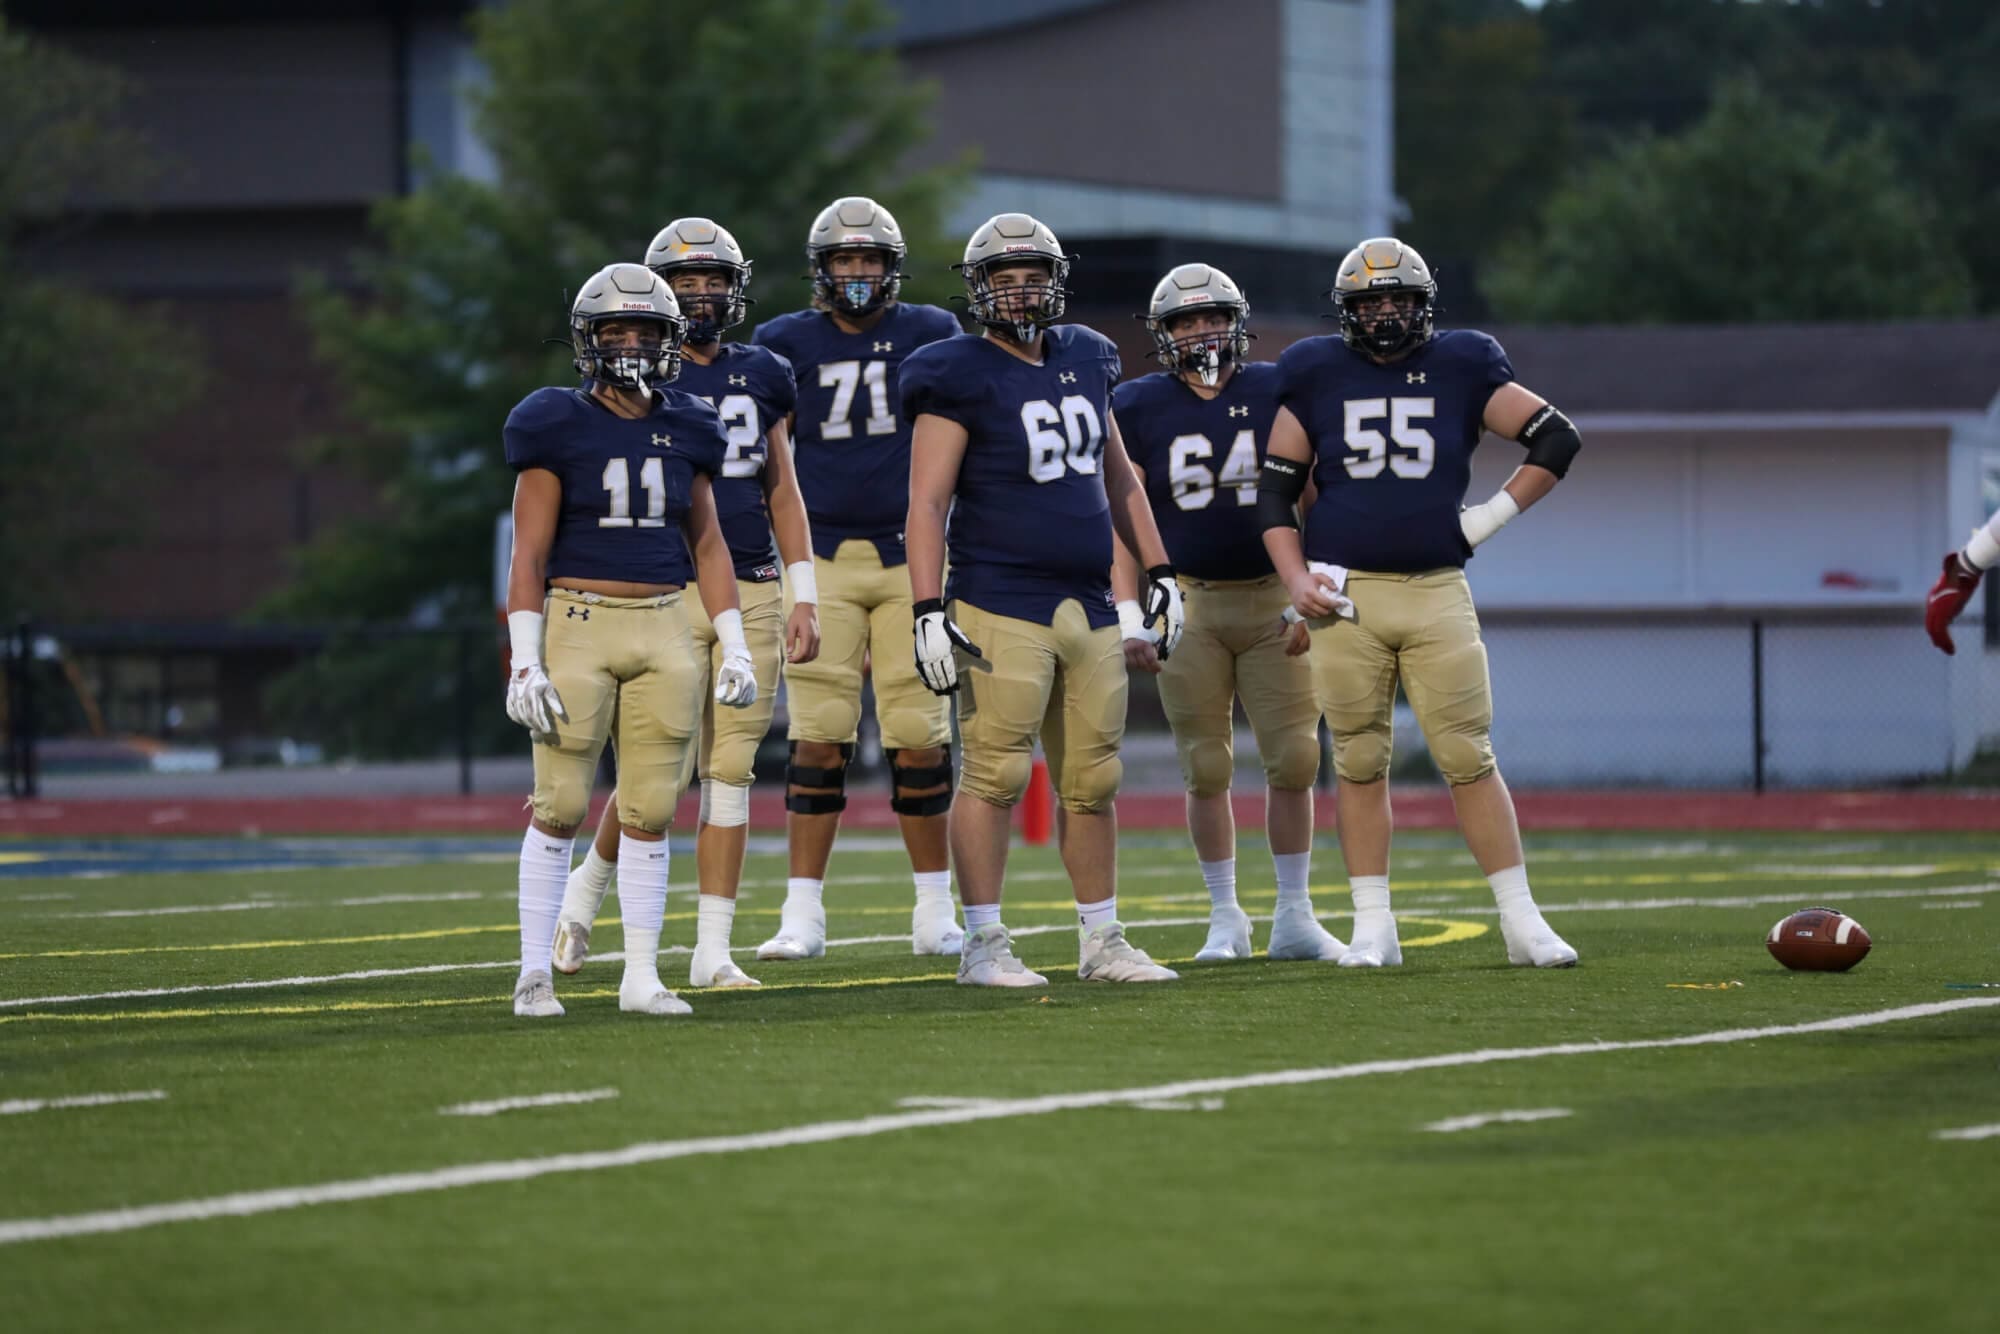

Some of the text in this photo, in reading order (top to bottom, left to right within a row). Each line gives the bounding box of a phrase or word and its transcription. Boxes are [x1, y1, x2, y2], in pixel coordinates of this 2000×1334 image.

[622, 302, 652, 310] Riddell
[703, 394, 768, 478] 2
[818, 360, 897, 440] 71
[1020, 394, 1101, 484] 60
[1343, 396, 1435, 479] 55
[598, 456, 666, 527] 11
[1169, 429, 1262, 511] 64
